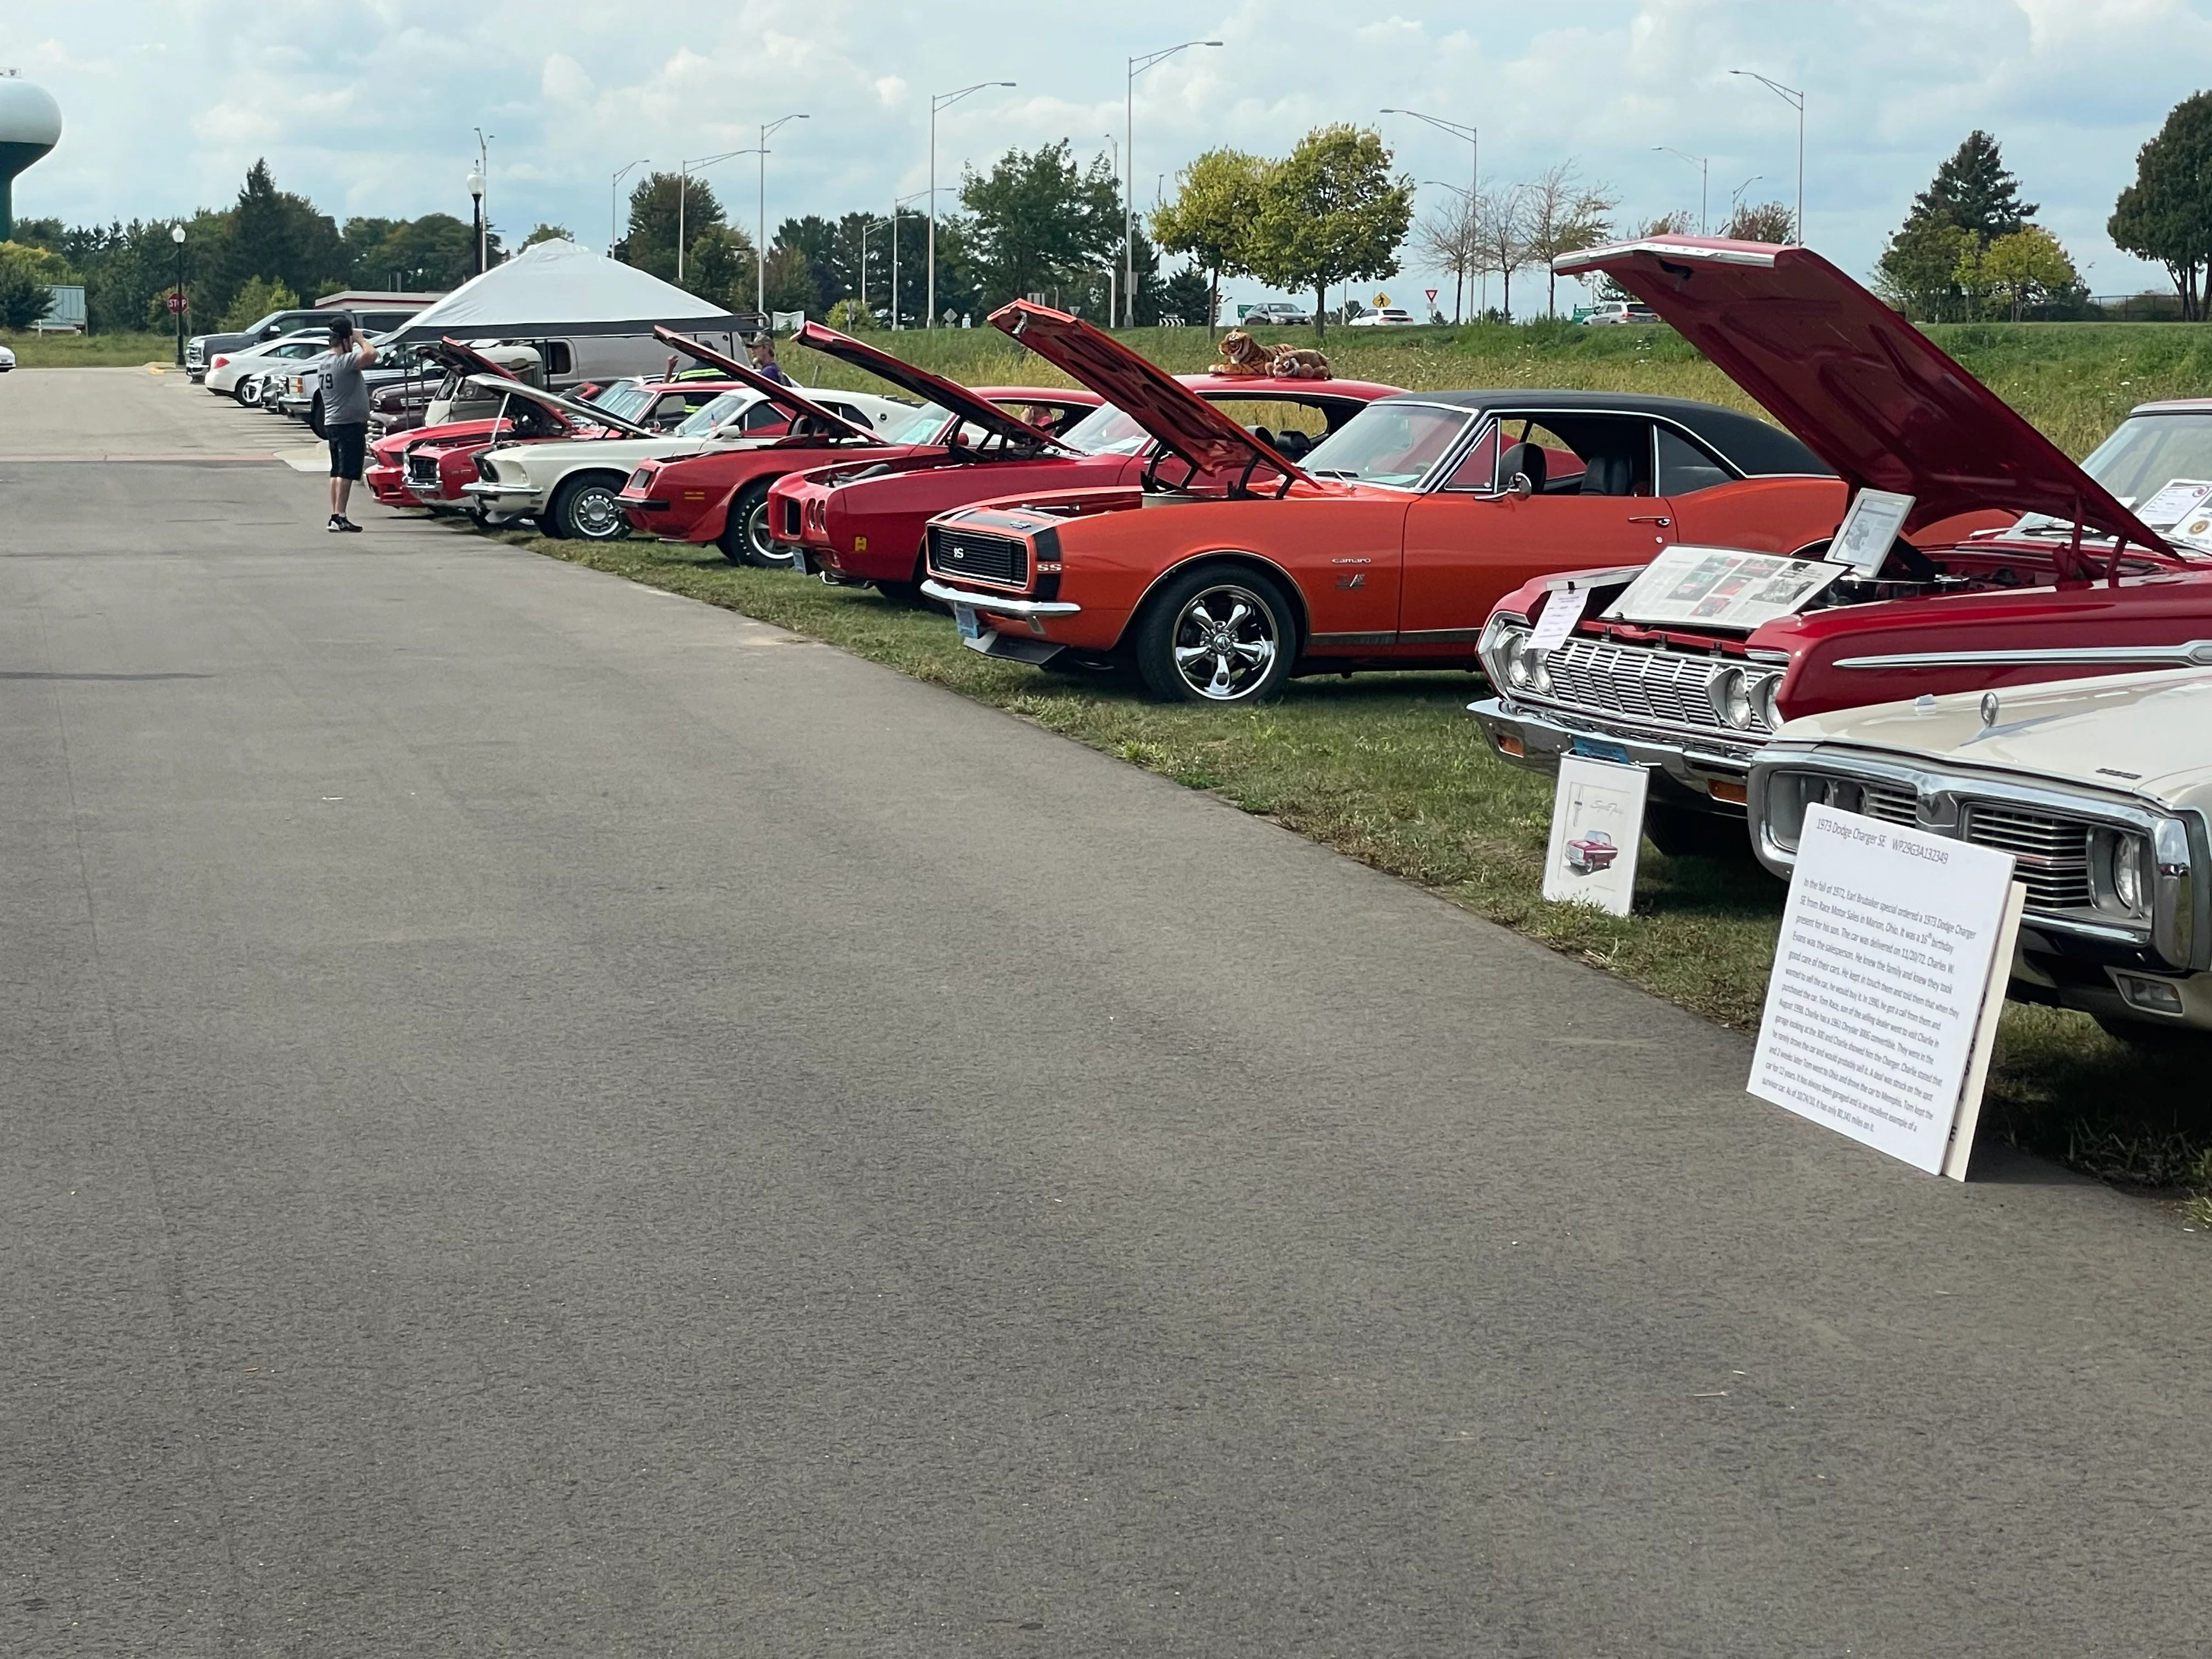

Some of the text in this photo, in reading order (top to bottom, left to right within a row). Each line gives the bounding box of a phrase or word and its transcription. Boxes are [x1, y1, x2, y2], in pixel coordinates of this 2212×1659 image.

[318, 374, 334, 390] 79
[1816, 818, 1832, 832] 1973
[1832, 822, 1852, 839] Dodge
[1852, 827, 1877, 845] Charger
[1877, 834, 1886, 847] SE
[1807, 897, 1818, 909] from
[1819, 901, 1830, 913] Race
[1830, 905, 1846, 917] Motor
[1846, 910, 1859, 922] Sales
[1865, 916, 1883, 931] Marion,
[1885, 922, 1898, 935] Ohio.
[1905, 931, 1916, 940] was
[1931, 938, 1954, 954] birthday
[1809, 880, 1818, 889] the
[1818, 881, 1826, 891] fall
[1832, 886, 1845, 899] 1972,
[1846, 890, 1857, 900] Earl
[1857, 893, 1880, 908] Brubaker
[1879, 902, 1897, 913] special
[1897, 908, 1919, 921] ordered
[1923, 915, 1937, 927] 1973
[1937, 918, 1954, 934] Dodge
[1955, 924, 1976, 939] Charger
[1792, 930, 1806, 943] Evans
[1807, 938, 1816, 947] was
[1816, 940, 1825, 950] the
[1825, 944, 1853, 960] salesperson.
[1863, 955, 1876, 967] knew
[1876, 960, 1885, 971] the
[1886, 962, 1901, 978] family
[1901, 970, 1913, 980] and
[1913, 972, 1926, 985] knew
[1927, 978, 1939, 991] they
[1939, 983, 1952, 994] took
[1796, 915, 1814, 927] present
[1830, 927, 1839, 935] son.
[1841, 927, 1850, 939] The
[1859, 936, 1869, 945] was
[1870, 938, 1893, 953] delivered
[1927, 956, 1946, 971] Charles
[1788, 951, 1801, 961] good
[1801, 955, 1812, 965] care
[1817, 960, 1829, 970] their
[1829, 965, 1839, 974] cars.
[1849, 970, 1860, 982] kept
[1866, 977, 1881, 989] touch
[1893, 989, 1903, 997] and
[1948, 1008, 1959, 1019] they
[1836, 987, 1849, 996] would
[1833, 1036, 1848, 1048] Charlie
[1900, 1063, 1916, 1076] Charlie
[1898, 1042, 1908, 1056] They
[1917, 1032, 1933, 1046] Charlie
